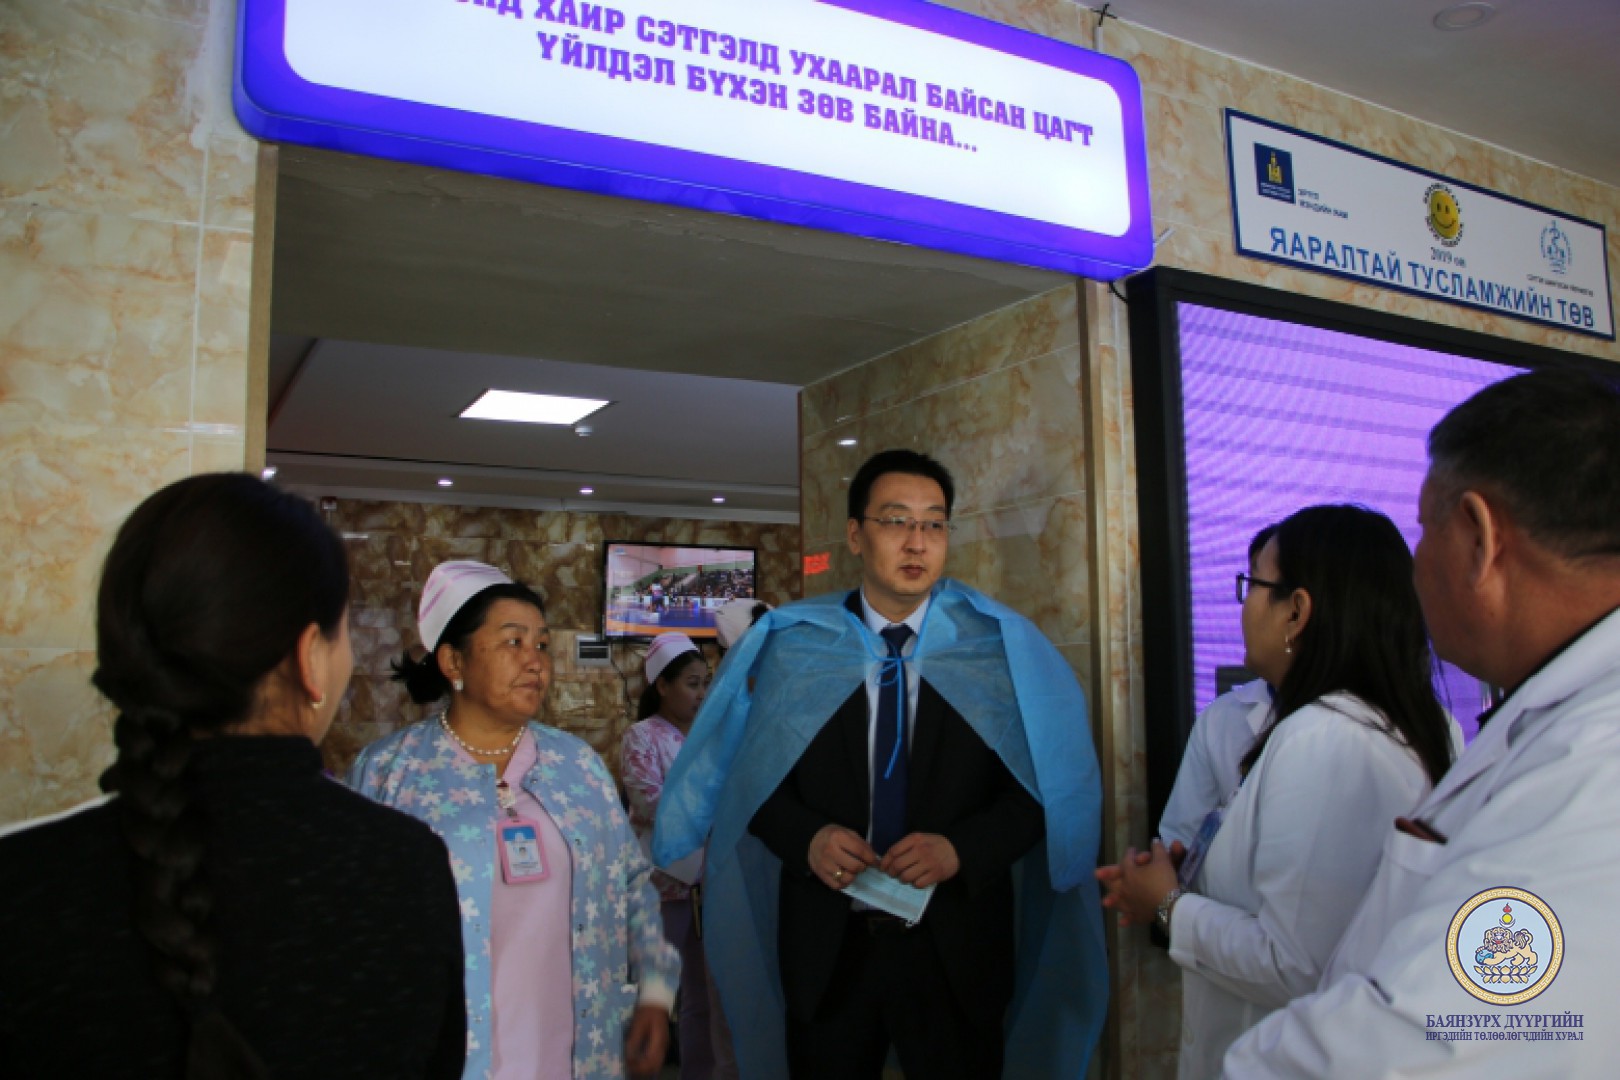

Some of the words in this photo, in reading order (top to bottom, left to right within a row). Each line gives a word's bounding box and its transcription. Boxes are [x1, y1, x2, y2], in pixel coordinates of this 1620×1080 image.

[537, 31, 675, 86] ҮЙЛДЭЛ
[687, 64, 787, 109] БҮХЭН
[797, 88, 854, 124] ЗӨВ
[864, 103, 978, 153] БАЙНА...
[636, 15, 780, 75] СЭТГЭЛД
[790, 49, 917, 102] УХААРАЛ
[925, 81, 1026, 131] БАЙСАН
[1033, 111, 1093, 146] ЦАГТ
[1270, 227, 1401, 282] ЯАРАЛТАЙ
[1408, 262, 1553, 319] ТУСЛАМЖИЙН
[1558, 299, 1594, 328] ТӨВ
